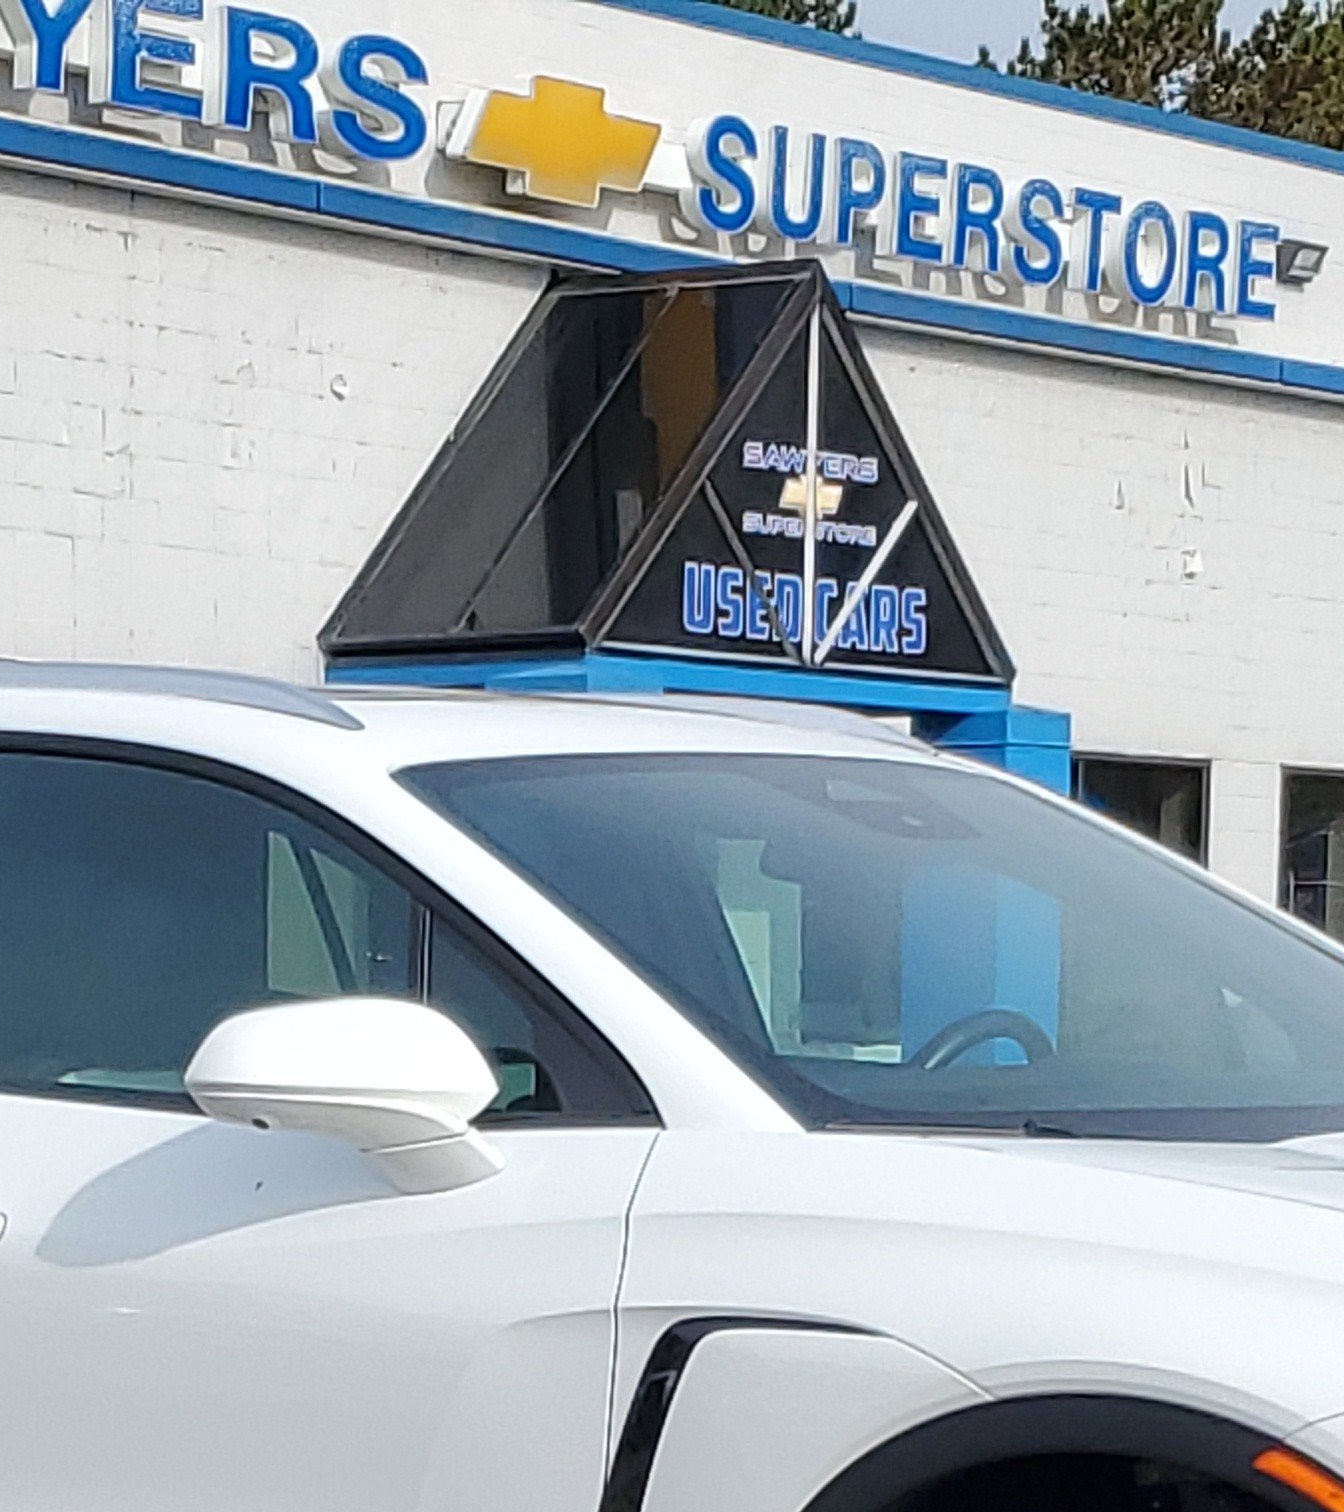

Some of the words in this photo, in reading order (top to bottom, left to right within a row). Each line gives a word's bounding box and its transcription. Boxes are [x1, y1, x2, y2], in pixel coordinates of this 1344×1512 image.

[698, 113, 1282, 321] SUPERSTORE
[742, 511, 877, 547] SUPESTORE
[682, 560, 803, 643] USED
[813, 577, 927, 655] CARS
